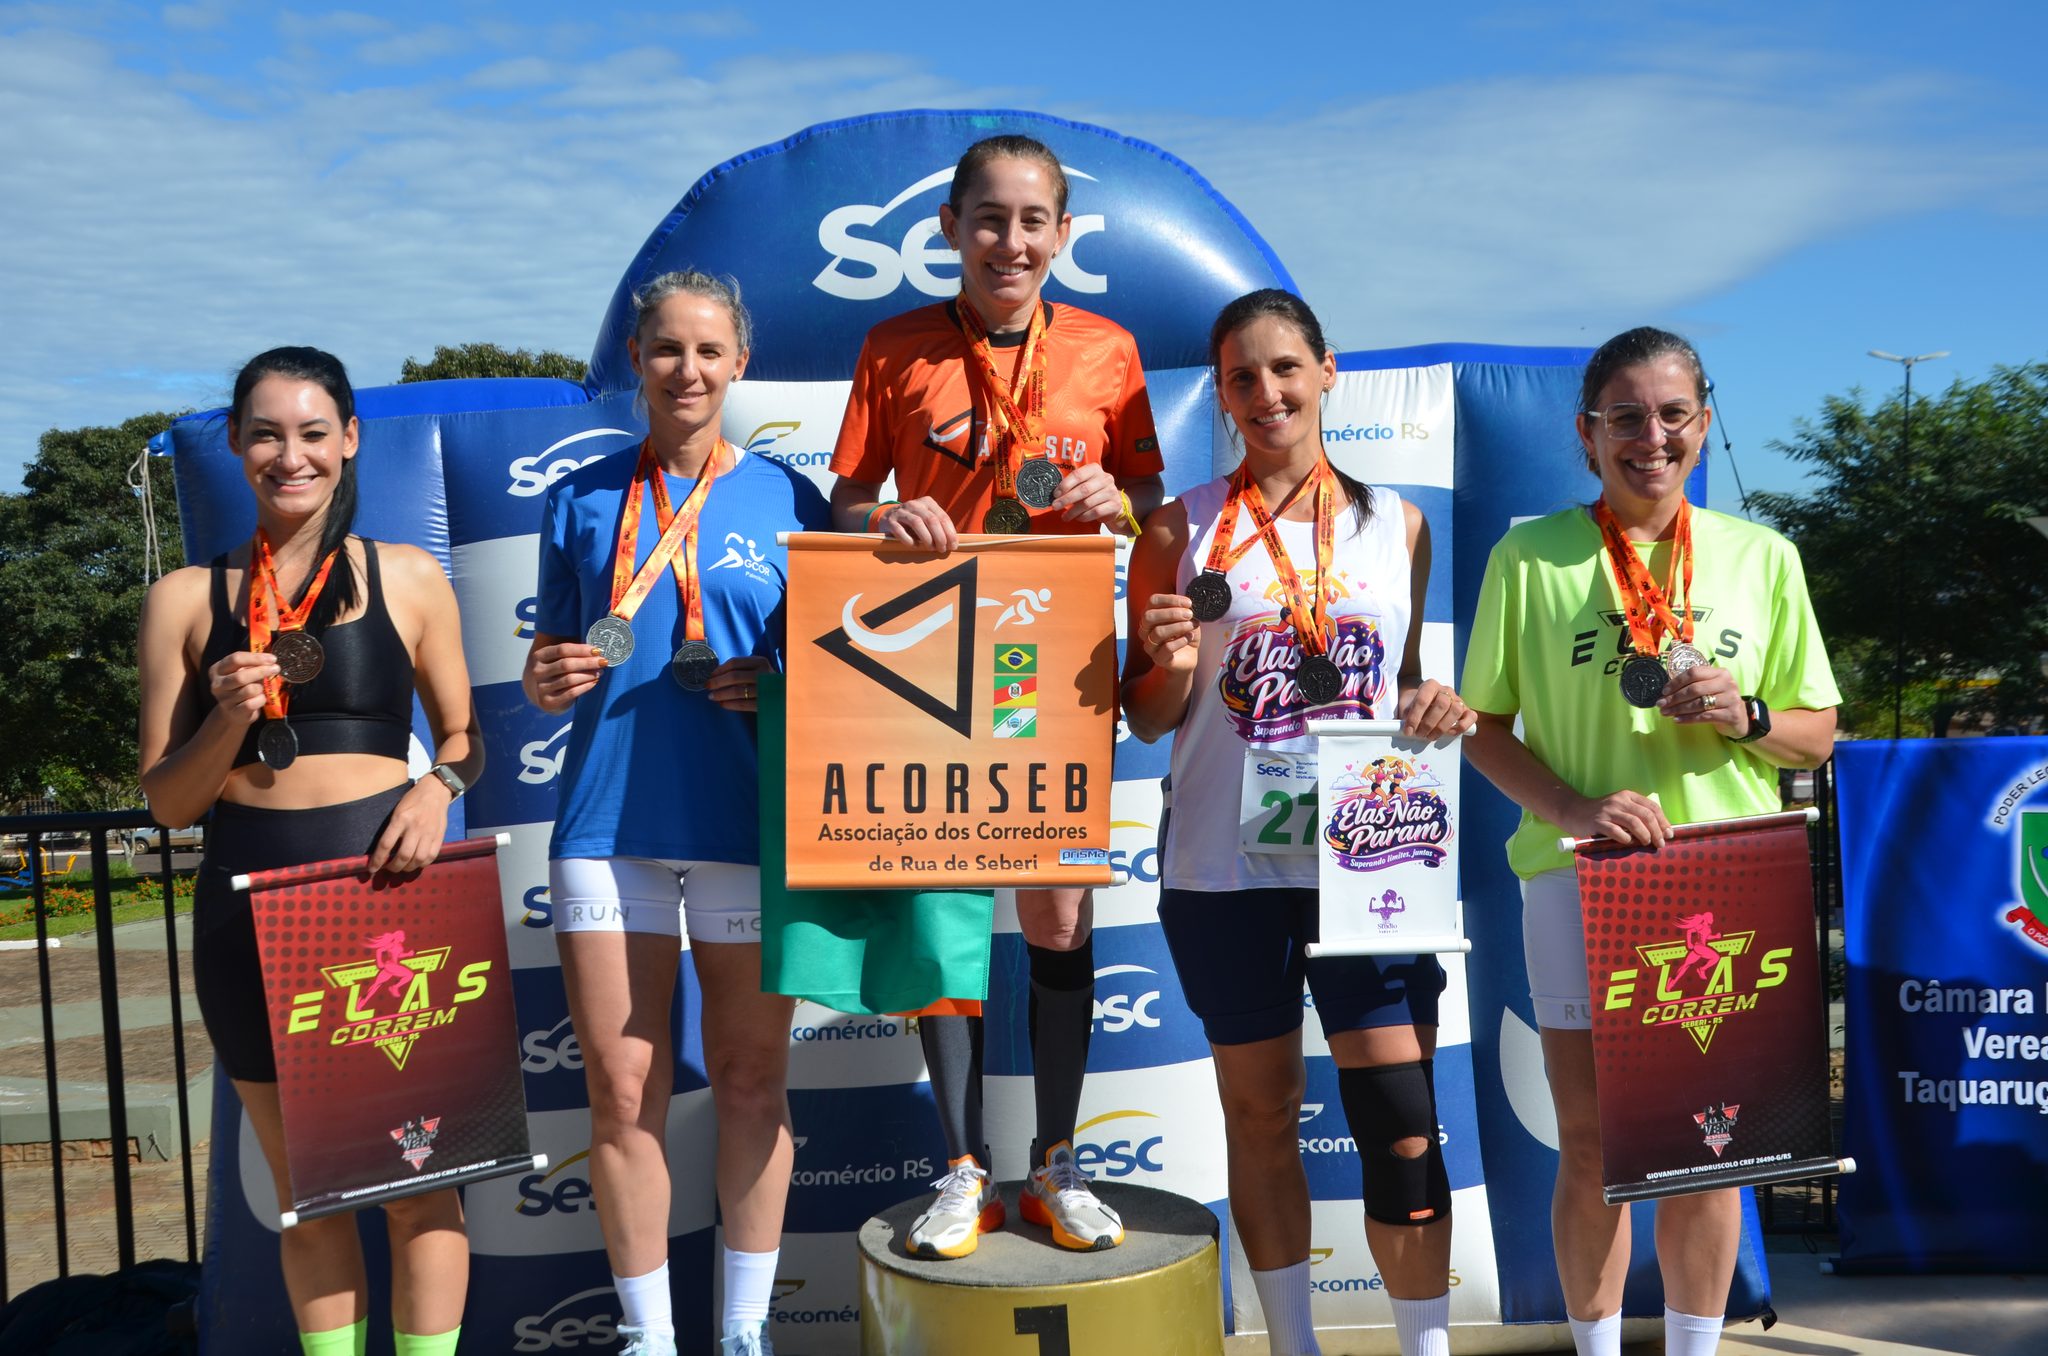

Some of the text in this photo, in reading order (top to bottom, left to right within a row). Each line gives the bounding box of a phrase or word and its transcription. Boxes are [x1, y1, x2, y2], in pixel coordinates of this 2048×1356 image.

[812, 204, 1107, 300] Sec
[978, 435, 1086, 462] ASEB
[1322, 422, 1429, 442] mércio RS
[507, 455, 608, 497] Se
[1257, 763, 1290, 778] Sesc
[822, 762, 1088, 815] ACORSEB
[1994, 783, 2029, 825] PODER
[1338, 799, 1436, 832] Elas Não
[818, 821, 1088, 845] Associação dos Corredores
[1347, 821, 1441, 856] Param
[869, 854, 1039, 871] de Rua de Seberi
[1350, 859, 1386, 869] Superando
[572, 905, 631, 922] RUN
[1604, 947, 1793, 1011] ELAS
[288, 961, 492, 1035] ELAS
[1642, 993, 1759, 1024] CORREM
[1899, 979, 2034, 1015] Câmara
[330, 1007, 458, 1045] CORREM
[790, 1019, 897, 1041] comércio
[1681, 1020, 1707, 1028] SEBERI
[520, 1030, 584, 1073] Se
[1898, 1072, 2048, 1114] Taquaruç
[791, 1158, 933, 1186] comércio RS
[1075, 1136, 1163, 1177] esc
[1646, 1168, 1689, 1180] GIOVANINHO
[1691, 1161, 1738, 1173] VENDRUSCOLO
[1740, 1158, 1755, 1166] CREF
[1013, 1303, 1071, 1356] 1
